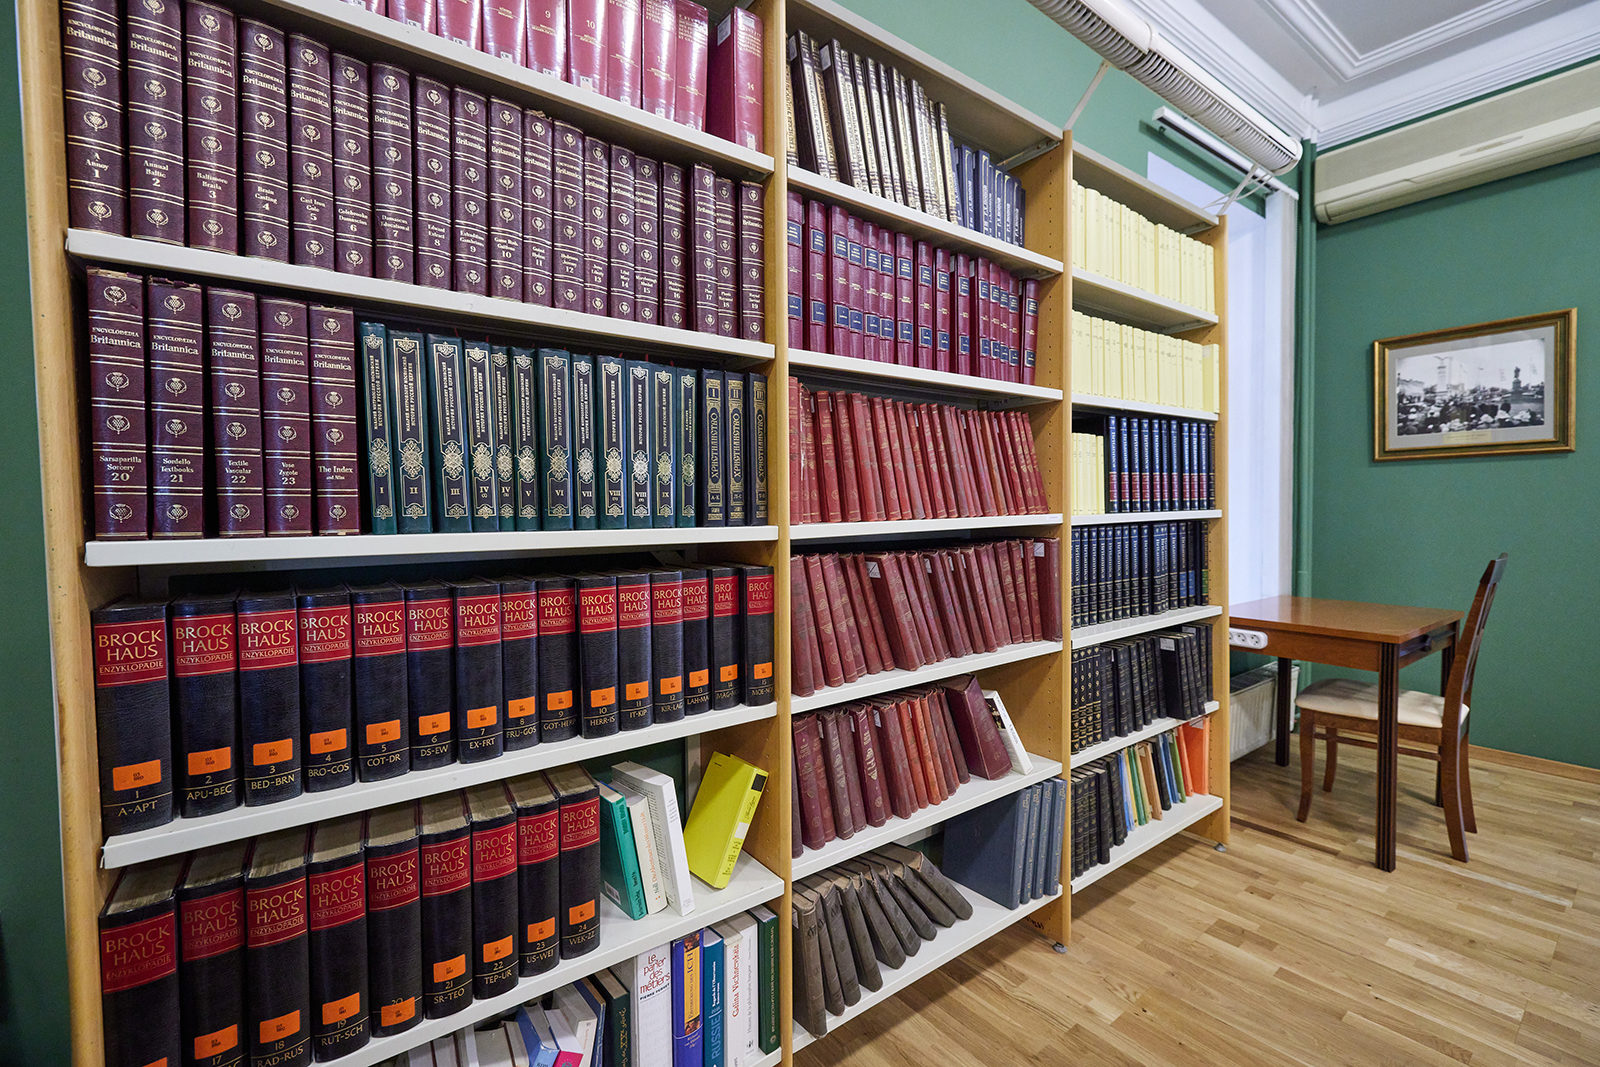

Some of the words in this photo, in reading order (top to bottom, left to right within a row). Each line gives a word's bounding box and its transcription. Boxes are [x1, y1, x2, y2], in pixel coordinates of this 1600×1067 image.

[545, 10, 551, 19] 9
[586, 19, 596, 30] 10
[66, 26, 119, 50] Britannica
[130, 40, 179, 62] Britannica
[188, 58, 233, 78] Britannica
[243, 75, 285, 96] Britannica
[290, 89, 330, 108] Britannica
[333, 105, 369, 123] Britannica
[85, 159, 110, 171] Annoy
[144, 160, 169, 171] Annual
[93, 169, 100, 178] 1
[145, 168, 167, 178] Baltic
[152, 177, 161, 187] 2
[208, 190, 217, 199] 3
[262, 202, 271, 211] 4
[309, 212, 318, 221] 5
[350, 223, 357, 232] 6
[392, 229, 399, 238] 7
[434, 239, 441, 247] 8
[501, 250, 512, 259] 10
[535, 258, 544, 267] 11
[565, 265, 574, 274] 12
[594, 275, 602, 283] 13
[643, 286, 651, 294] 15
[673, 292, 681, 300] 16
[705, 293, 713, 301] 17
[751, 301, 759, 309] 19
[90, 335, 142, 349] Britannica
[151, 341, 200, 356] Britannica
[211, 348, 256, 361] Britannica
[264, 355, 306, 367] Britannica
[313, 360, 352, 371] Britannica
[99, 455, 142, 464] Sarsaparilla
[162, 458, 192, 466] Sordello
[228, 460, 249, 468] Textile
[106, 463, 135, 473] Sorcery
[161, 465, 195, 474] Textbooks
[224, 467, 252, 475] Vascular
[278, 469, 299, 478] Zygote
[318, 465, 333, 473] The
[333, 465, 354, 474] Index
[111, 472, 131, 482] 20
[169, 474, 185, 483] 21
[231, 475, 247, 484] 22
[281, 476, 296, 485] 23
[379, 486, 384, 494] I
[409, 487, 418, 495] II
[450, 488, 461, 496] III
[501, 486, 511, 494] IV
[555, 489, 564, 497] VI
[608, 489, 621, 497] VIII
[459, 602, 499, 616] BROCK
[502, 599, 536, 612] BROCK
[357, 609, 403, 624] BROCK
[408, 606, 450, 620] BROCK
[505, 609, 534, 622] HAUS
[301, 614, 349, 630] BROCK
[414, 618, 449, 631] HAUS
[464, 614, 497, 627] HAUS
[175, 623, 233, 640] BROCK
[241, 619, 295, 635] BROCK
[363, 622, 400, 636] HAUS
[99, 629, 163, 648] BROCK
[306, 627, 346, 641] HAUS
[182, 637, 229, 653] HAUS
[248, 633, 291, 648] HAUS
[107, 644, 158, 662] HAUS
[241, 645, 295, 659] ENZYKLOPÄDIE
[176, 652, 233, 665] ENZYKLOPÄDIE
[100, 660, 164, 674] ENZYKLOPÄDIE
[558, 710, 564, 718] 9
[598, 707, 608, 715] 10
[519, 718, 525, 726] 8
[480, 728, 486, 736] 7
[506, 726, 537, 739] FRU-GOS
[469, 737, 496, 750] EX-FRT
[420, 745, 448, 757] DS-EW
[366, 753, 402, 767] COT-DR
[308, 763, 350, 778] BRO-COS
[251, 773, 296, 790] BED-BRN
[186, 784, 233, 801] APU-BEC
[117, 800, 158, 817] A-APT
[424, 844, 469, 865] BROCK
[370, 857, 416, 879] BROCK
[430, 857, 465, 876] HAUS
[312, 872, 363, 896] BROCK
[376, 870, 414, 890] HAUS
[250, 887, 305, 912] BROCK
[318, 886, 359, 908] HAUS
[184, 900, 242, 925] BROCK
[256, 902, 301, 924] HAUS
[191, 913, 238, 937] HAUS
[578, 924, 587, 933] 24
[105, 924, 171, 953] BROCK
[568, 931, 596, 946] WEK-ZZ
[536, 941, 546, 950] 23
[114, 940, 166, 966] HAUS
[647, 953, 657, 965] Le
[493, 962, 504, 971] 22
[643, 956, 667, 977] parler
[484, 969, 513, 985] TEP-UR
[649, 968, 663, 980] des
[445, 981, 454, 990] 21
[639, 971, 671, 994] métiers
[433, 988, 466, 1005] SR-TEO
[337, 1019, 347, 1029] 19
[321, 1024, 364, 1047] RUT-SCH
[711, 1015, 722, 1059] RUSSIE
[274, 1040, 285, 1051] 18
[212, 1055, 222, 1066] 17
[257, 1046, 304, 1067] RAD-RUS
